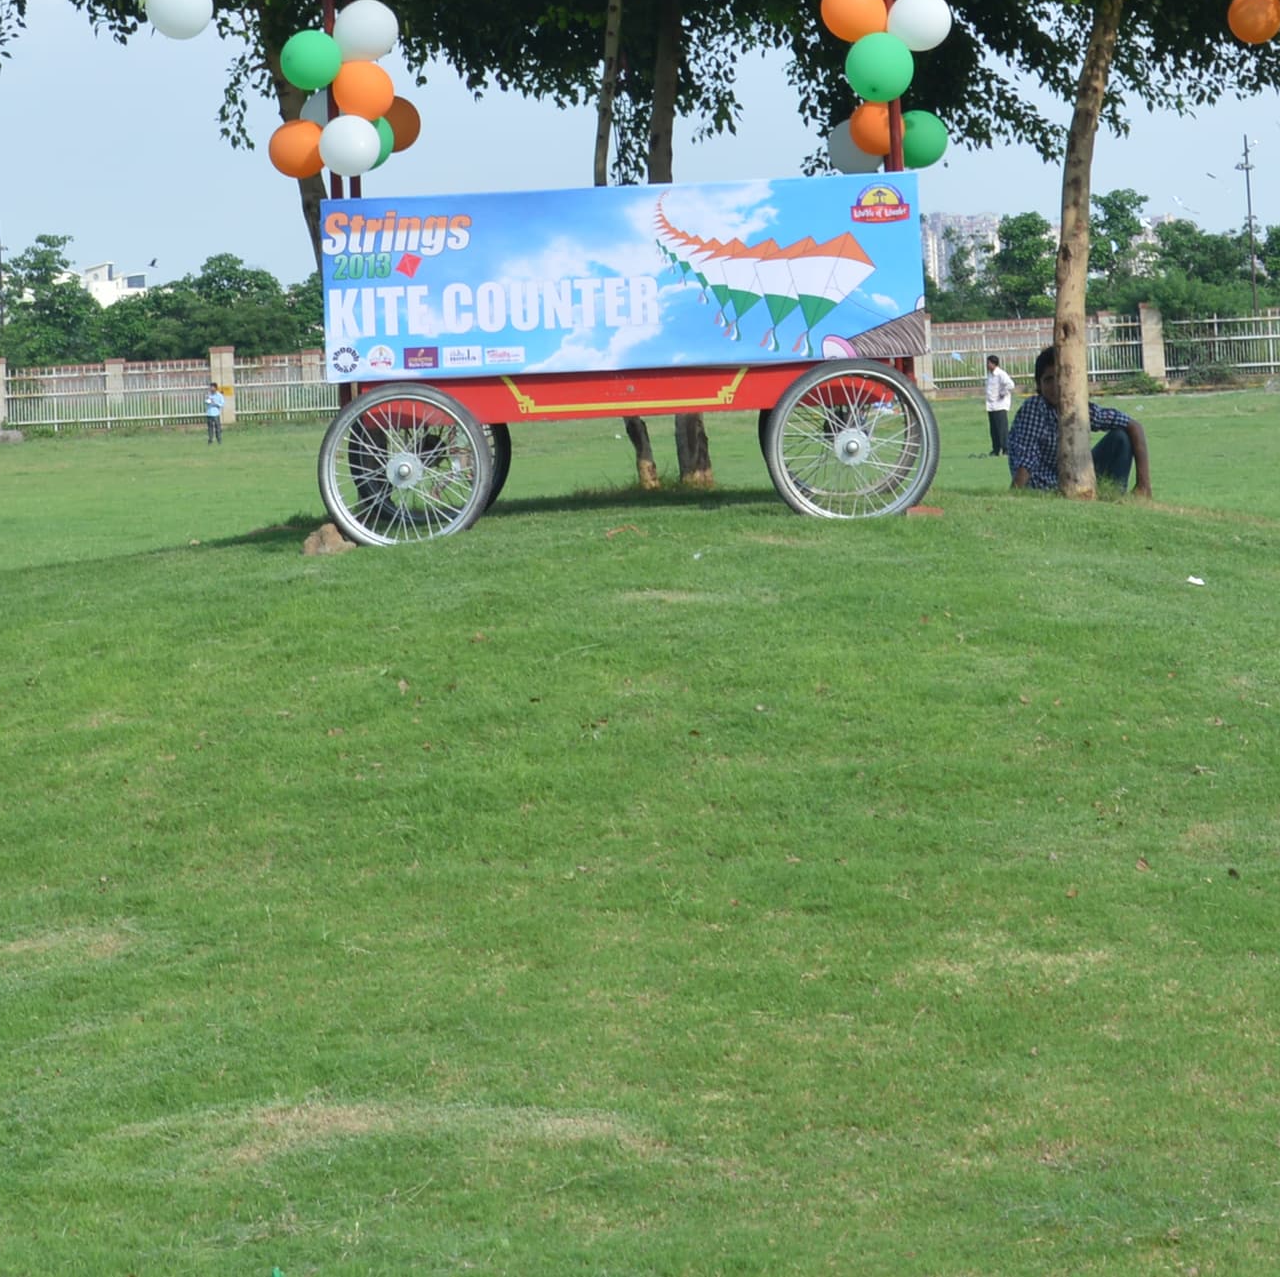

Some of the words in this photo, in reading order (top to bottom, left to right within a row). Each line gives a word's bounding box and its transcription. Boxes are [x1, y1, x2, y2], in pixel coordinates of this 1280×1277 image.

[322, 210, 472, 256] Strings
[332, 252, 392, 281] 2013
[327, 286, 428, 339] KITE
[443, 276, 659, 333] COUNTER
